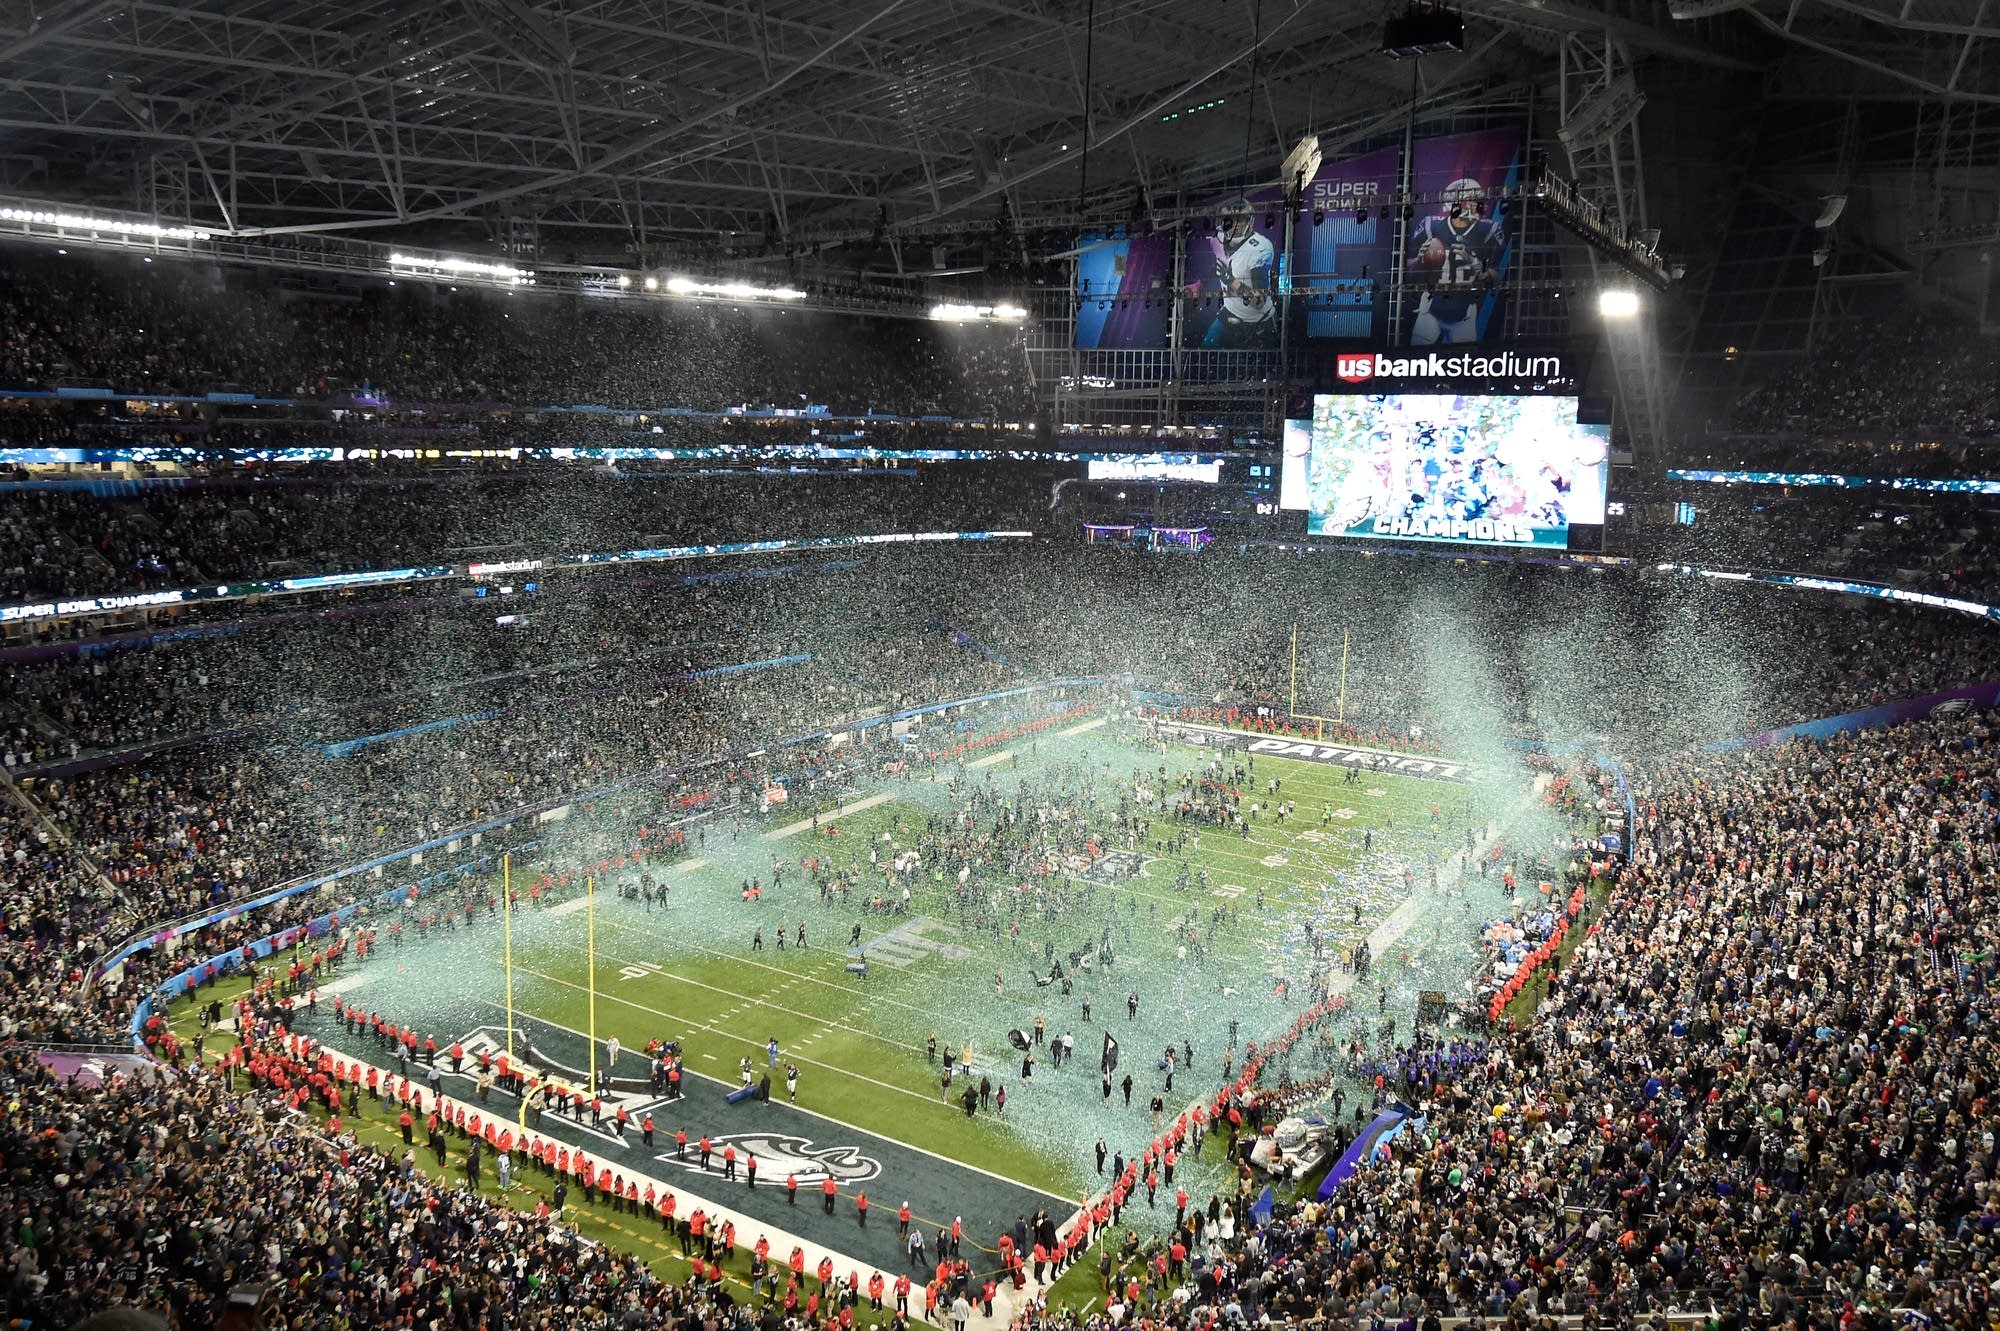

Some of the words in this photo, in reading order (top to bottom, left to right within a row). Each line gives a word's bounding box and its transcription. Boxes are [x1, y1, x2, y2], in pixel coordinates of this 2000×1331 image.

[1314, 183, 1378, 197] SUPER
[1373, 515, 1534, 542] CHAMPIONS
[3, 605, 54, 620] SUPER
[58, 600, 100, 614] BOWL
